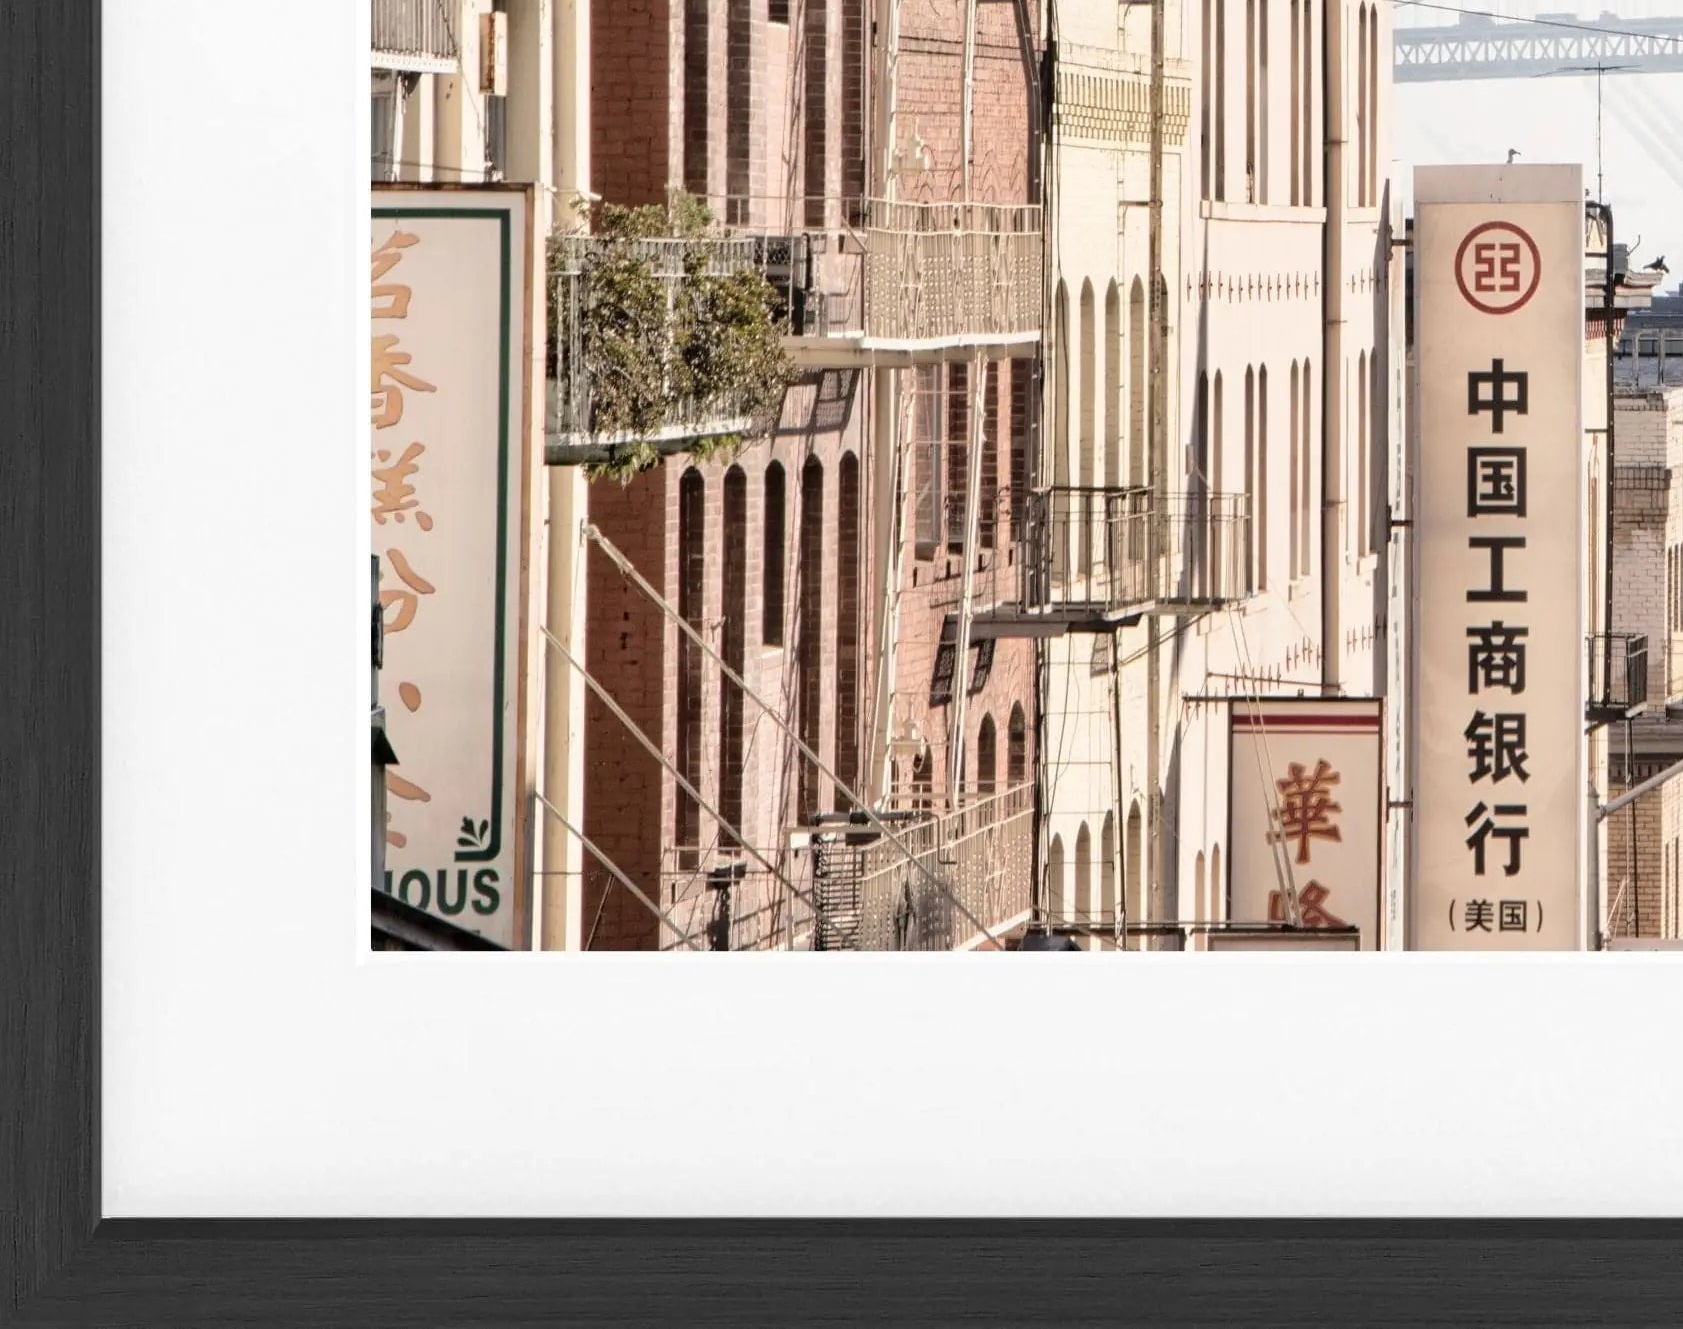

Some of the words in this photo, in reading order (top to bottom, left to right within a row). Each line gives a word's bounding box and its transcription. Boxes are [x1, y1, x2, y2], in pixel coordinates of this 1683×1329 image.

[1463, 358, 1531, 877] 中国工商银行
